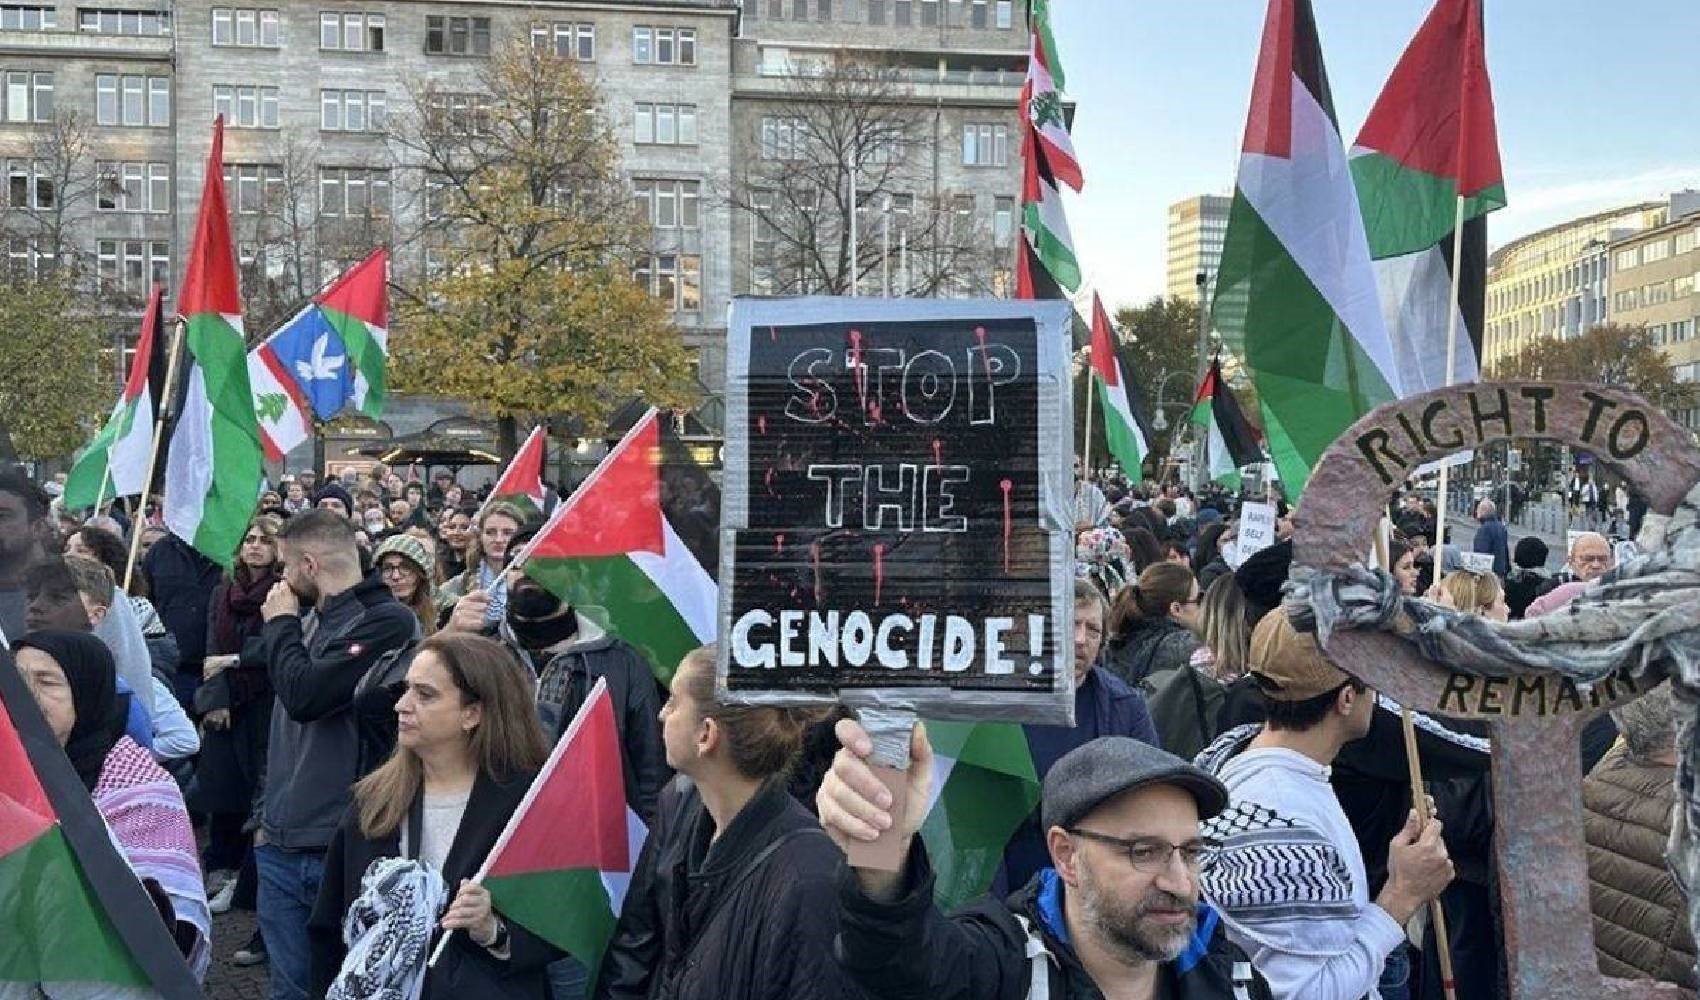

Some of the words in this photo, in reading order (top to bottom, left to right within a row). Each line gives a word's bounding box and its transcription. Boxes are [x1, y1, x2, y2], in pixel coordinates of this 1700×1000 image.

[784, 345, 1021, 426] STOP
[1355, 386, 1554, 486] RIGHT
[1579, 390, 1651, 460] TO
[807, 463, 970, 532] THE
[731, 608, 1046, 676] GENOCIDE!
